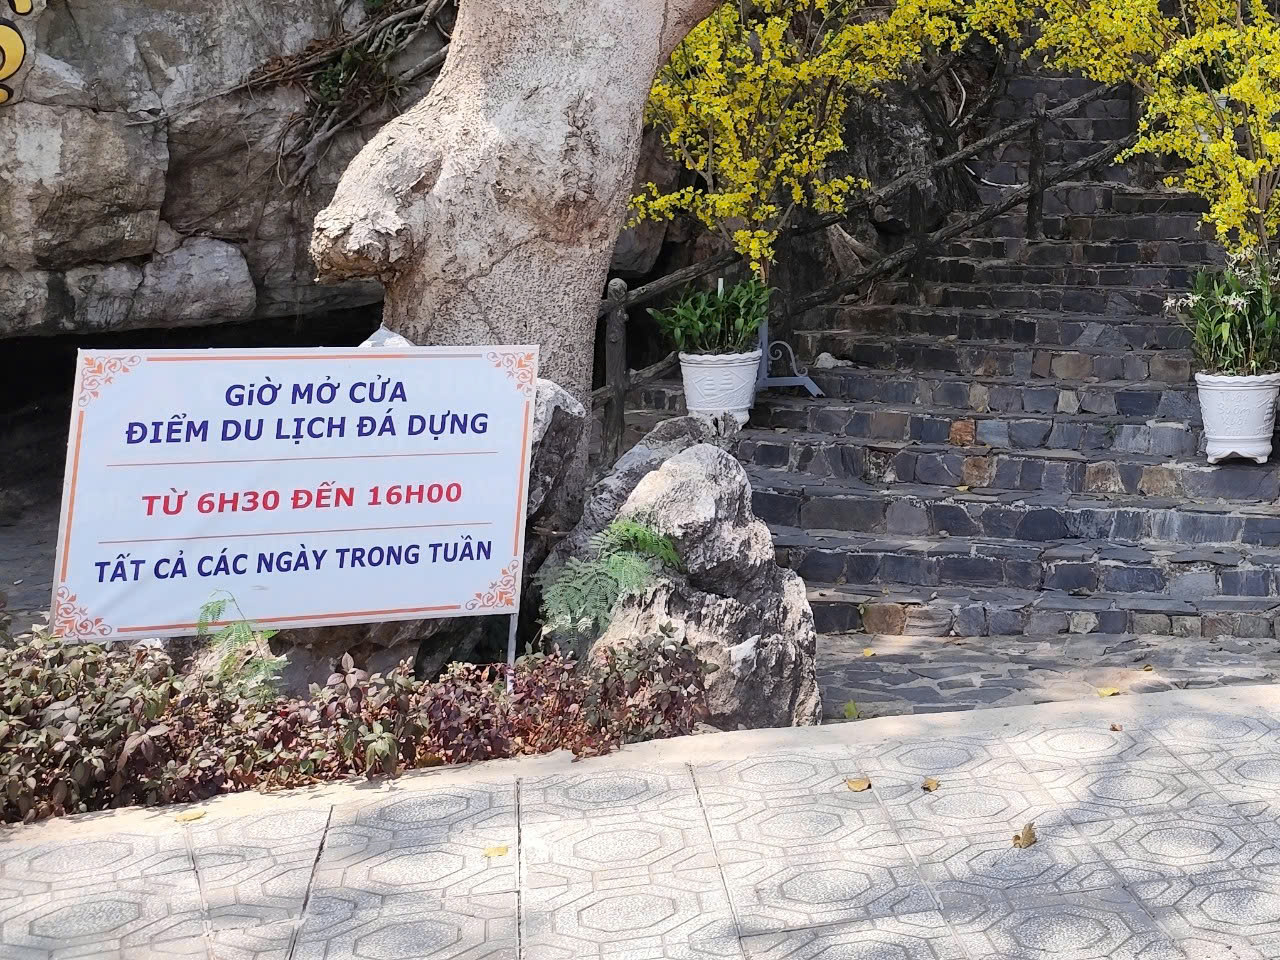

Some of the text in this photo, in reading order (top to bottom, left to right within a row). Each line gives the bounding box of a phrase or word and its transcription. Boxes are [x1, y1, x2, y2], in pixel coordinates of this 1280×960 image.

[291, 375, 340, 405] MỞ
[349, 373, 407, 403] CỬA
[126, 407, 488, 445] ĐIỂM DU LỊCH ĐÁ DỰNG
[141, 480, 462, 516] TỪ 6H30 ĐẾN 16H00
[94, 535, 492, 583] TẤT CẢ CÁC NGÀY TRONG TUẦN
